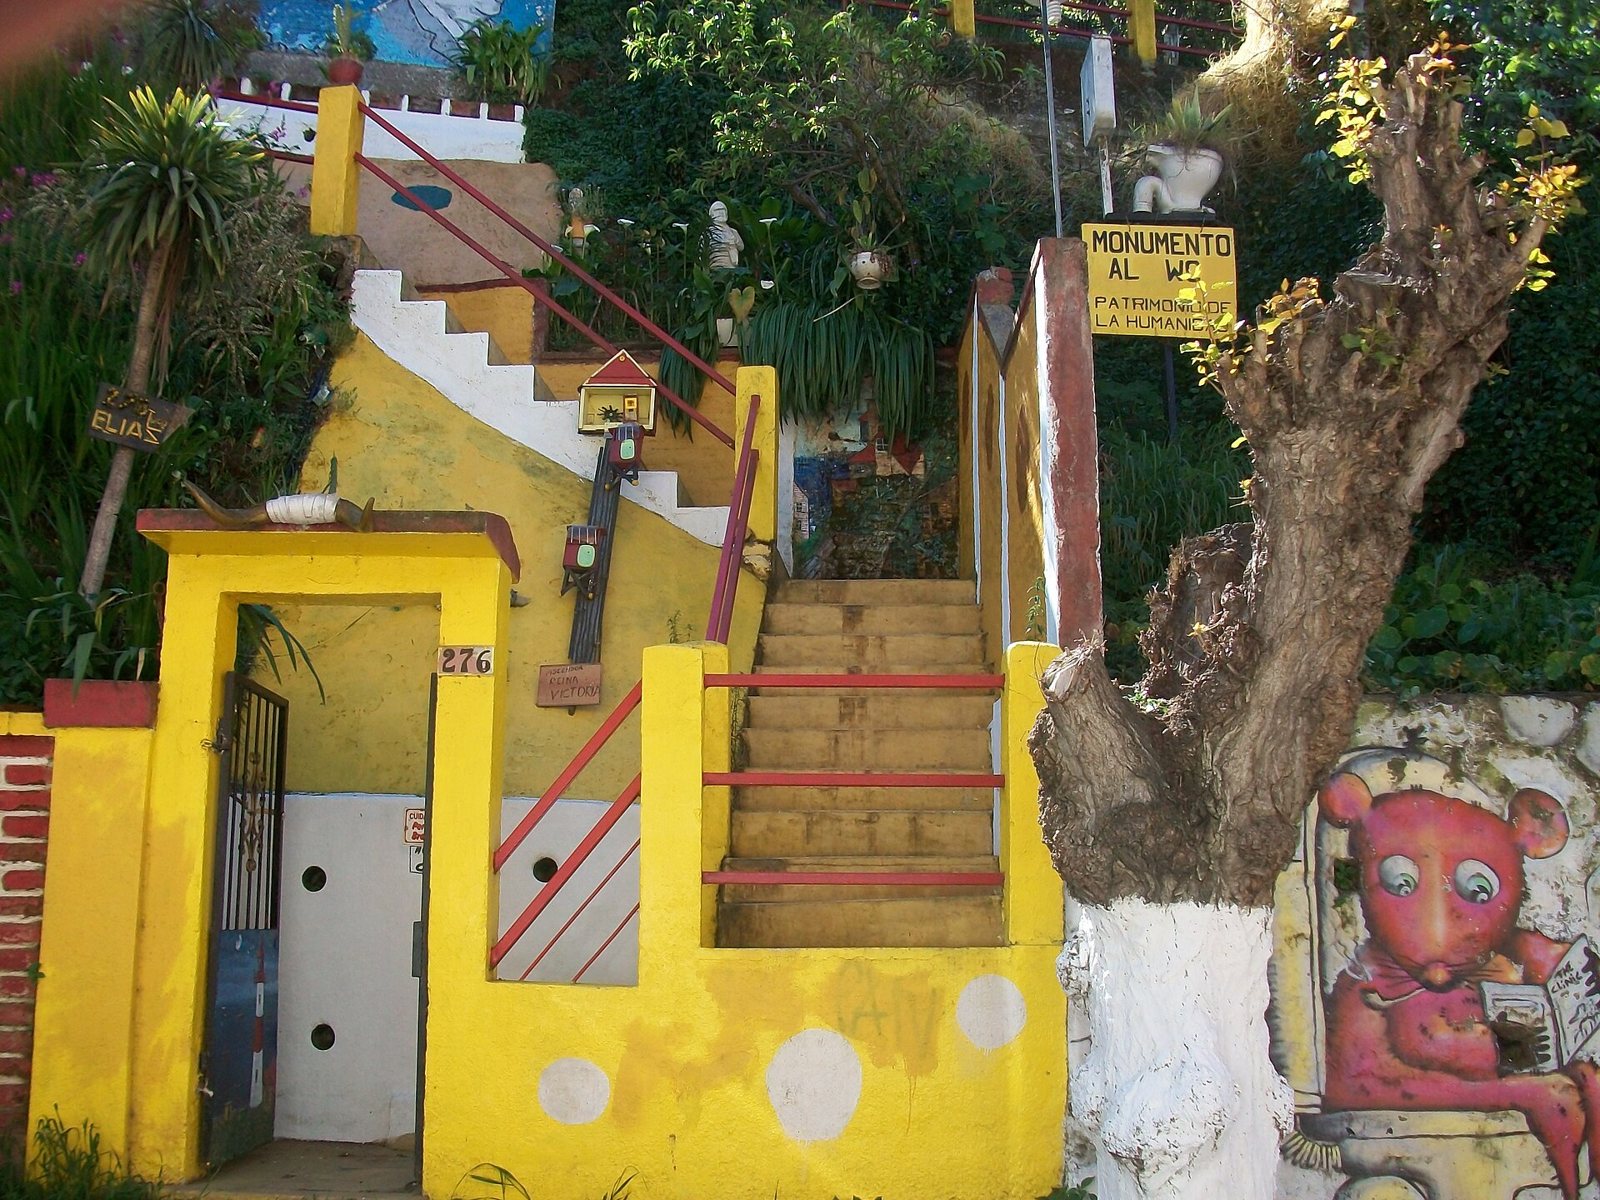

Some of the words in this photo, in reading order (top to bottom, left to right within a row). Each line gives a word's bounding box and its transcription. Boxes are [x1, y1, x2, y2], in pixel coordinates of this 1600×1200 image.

[1092, 230, 1231, 257] MONUMENTO
[1108, 257, 1140, 280] AL
[1165, 258, 1201, 282] WC
[1094, 296, 1202, 314] PATRIMONIO
[1207, 301, 1232, 314] DE
[1095, 314, 1120, 328] LA
[441, 648, 491, 674] 276
